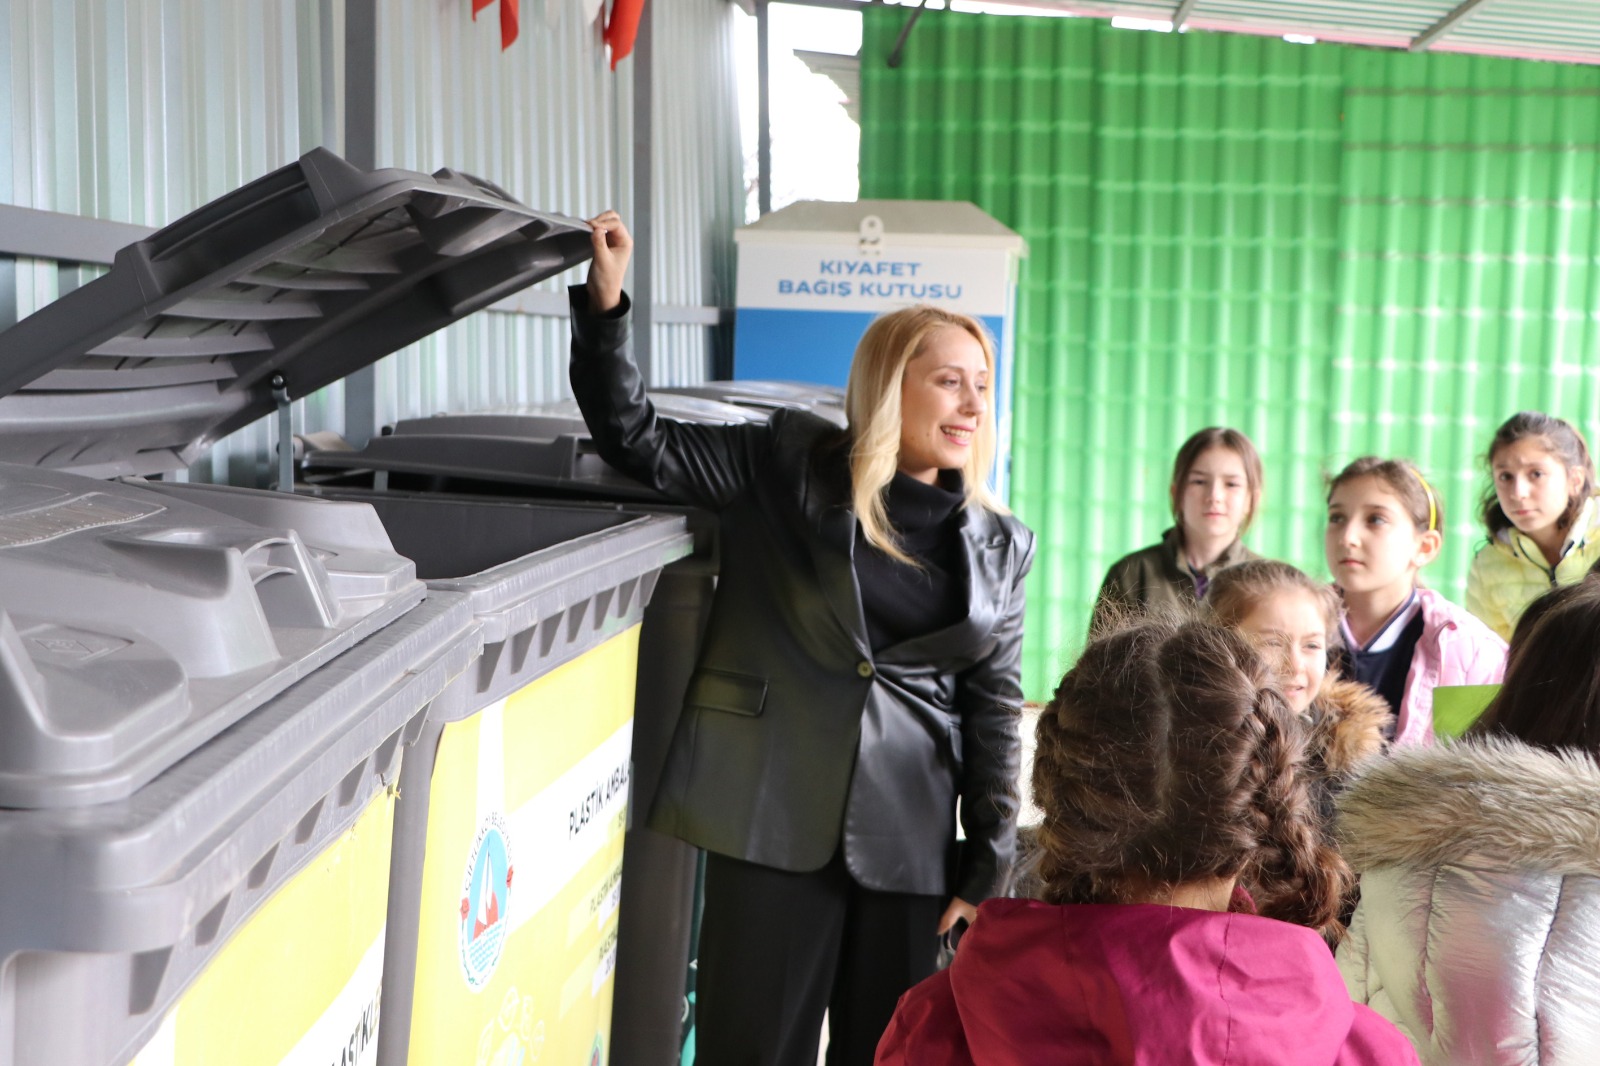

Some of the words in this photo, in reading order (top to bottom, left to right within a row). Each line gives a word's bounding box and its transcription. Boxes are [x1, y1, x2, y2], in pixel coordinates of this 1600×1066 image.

[820, 259, 922, 277] KIYAFET
[778, 279, 853, 297] BAĞIŞ
[860, 282, 963, 300] KUTUSU
[569, 780, 604, 841] PLASTİK
